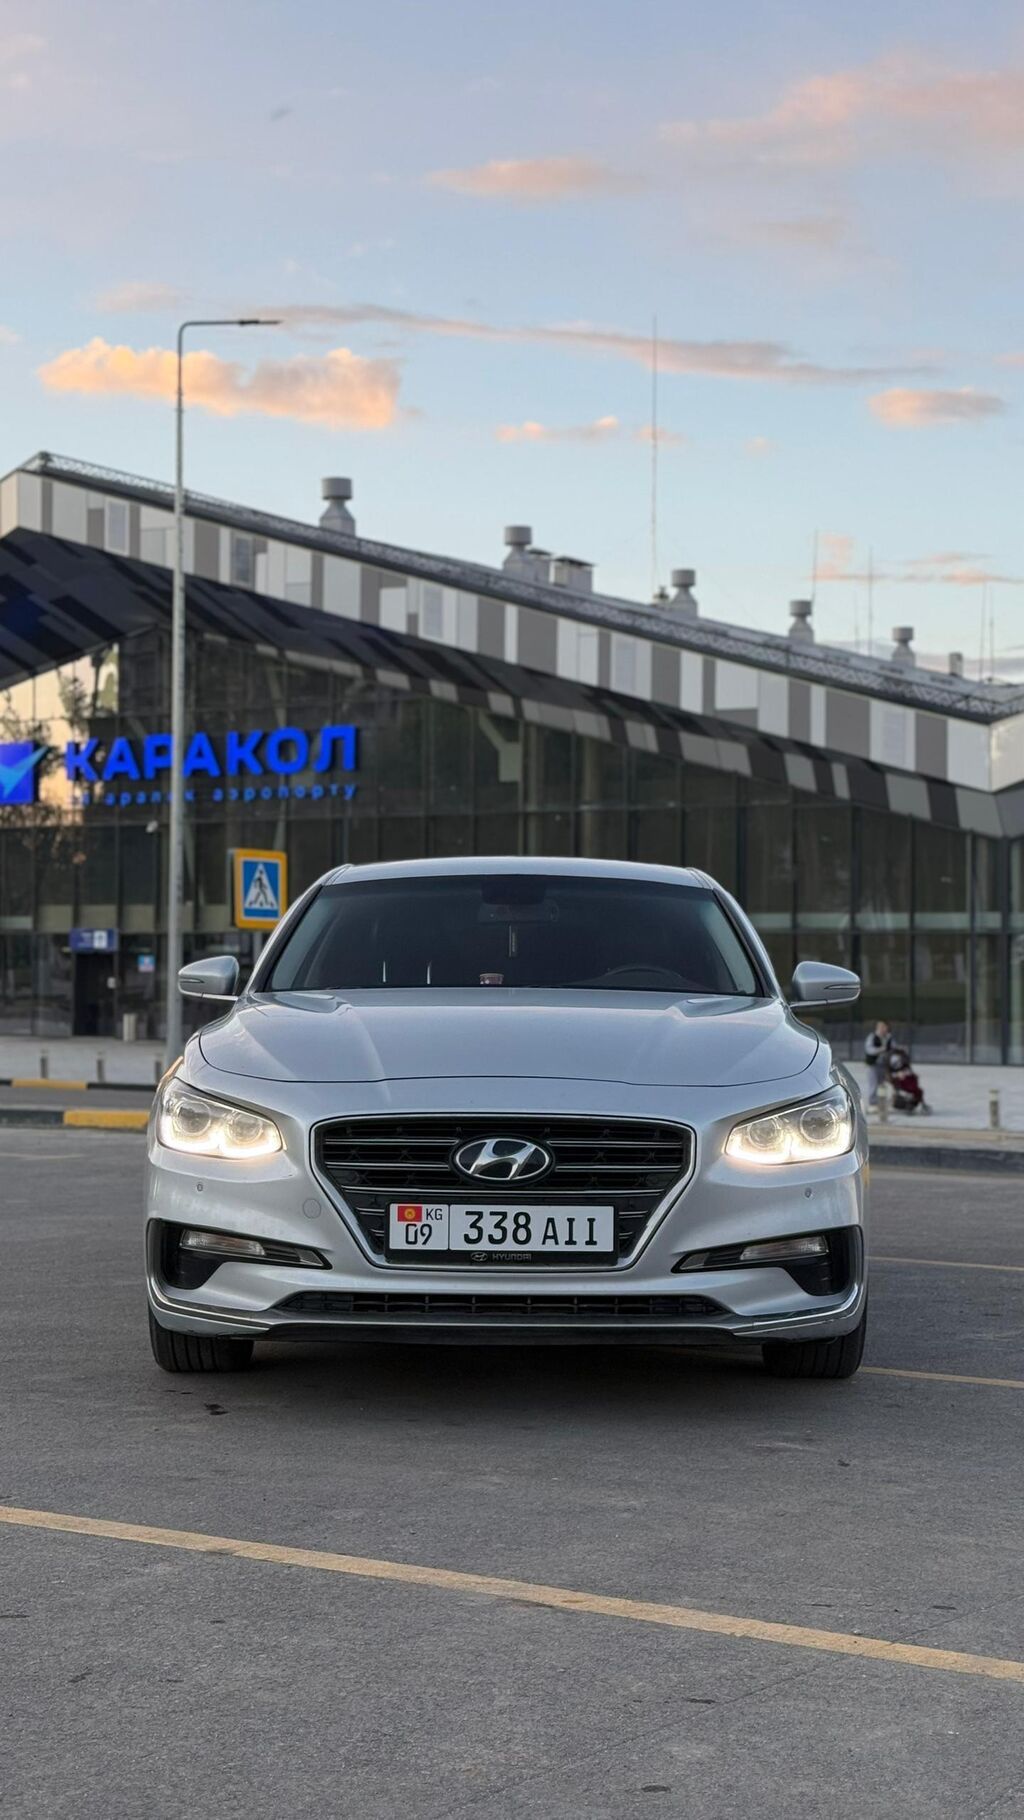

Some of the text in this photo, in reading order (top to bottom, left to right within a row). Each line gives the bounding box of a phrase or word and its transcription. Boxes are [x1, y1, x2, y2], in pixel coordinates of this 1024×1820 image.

[65, 724, 357, 781] КАРАКОЛ
[425, 1208, 443, 1221] KG
[405, 1223, 432, 1246] 09
[463, 1210, 598, 1246] 338 AII
[492, 1253, 532, 1261] HYUNDAI
